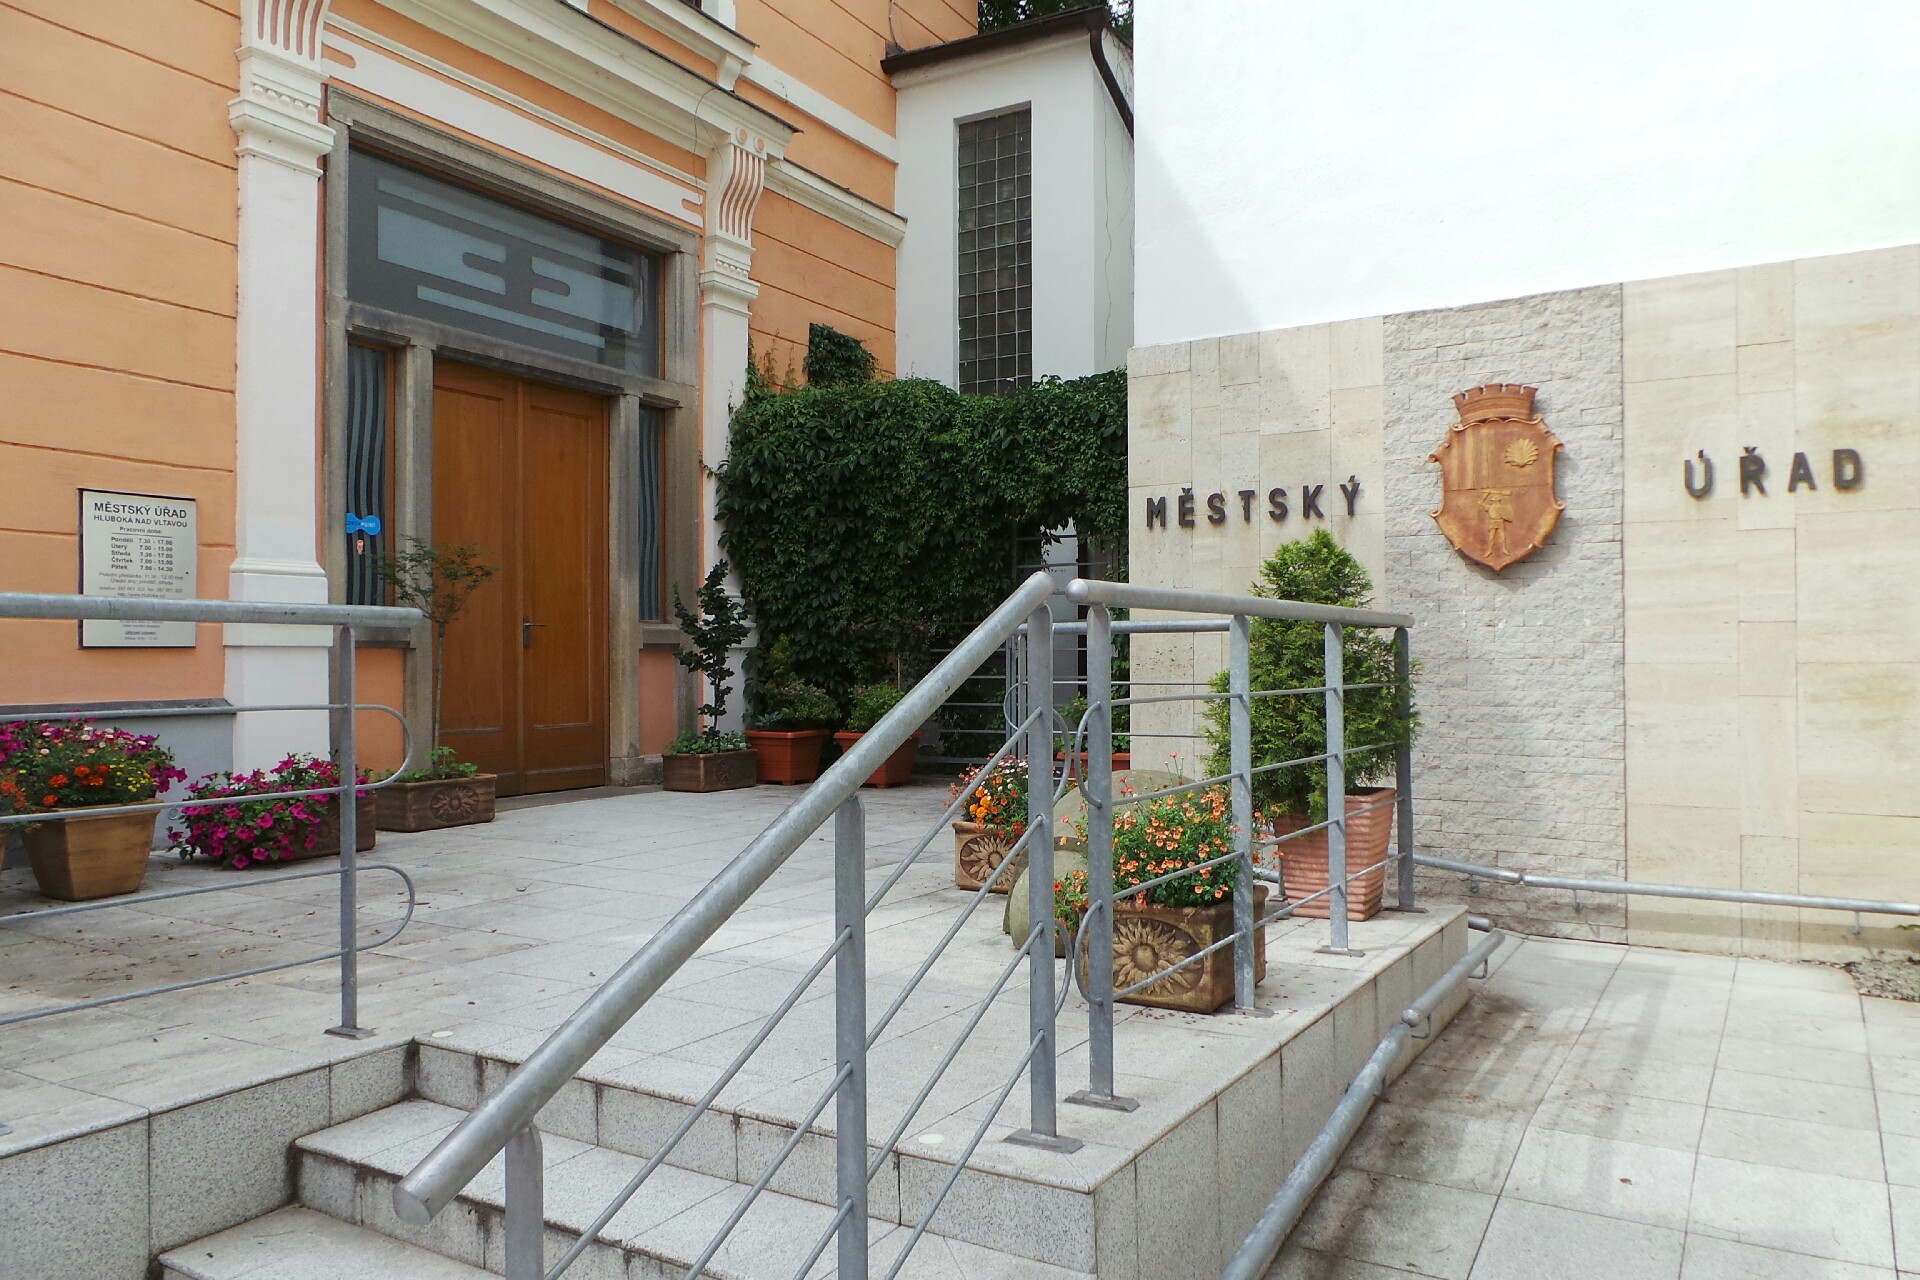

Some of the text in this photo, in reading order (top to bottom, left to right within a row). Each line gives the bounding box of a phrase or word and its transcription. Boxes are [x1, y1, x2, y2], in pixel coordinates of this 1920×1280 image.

[1146, 447, 1864, 528] MĚSTSKÝ ÚŘAD
[94, 501, 187, 518] MĚSTSKÝ ÚŘAD
[154, 519, 187, 528] VLTAVOU
